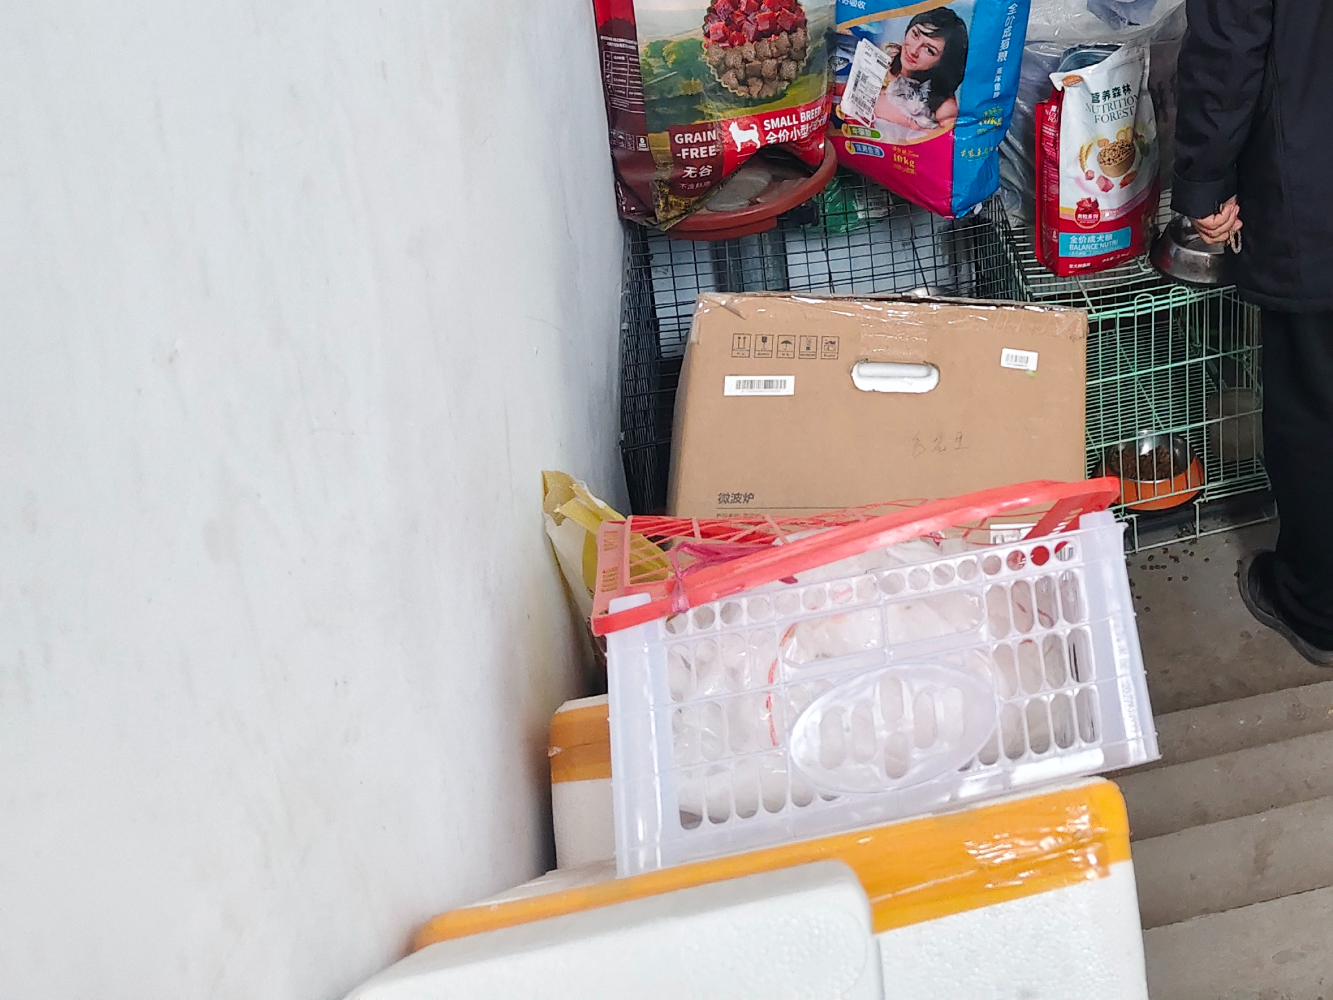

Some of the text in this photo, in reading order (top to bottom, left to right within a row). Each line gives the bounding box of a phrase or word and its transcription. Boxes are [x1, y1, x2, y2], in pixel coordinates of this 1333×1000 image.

[1090, 83, 1132, 104] 营养森林
[1094, 105, 1135, 124] FOREST
[763, 115, 799, 131] SMALL
[674, 130, 718, 145] GRAIN
[892, 153, 916, 168] 10kg
[682, 165, 714, 180] 无谷
[1069, 233, 1113, 244] 全价成犬粮
[1069, 243, 1099, 251] BALANCE
[717, 492, 755, 505] 微波炉
